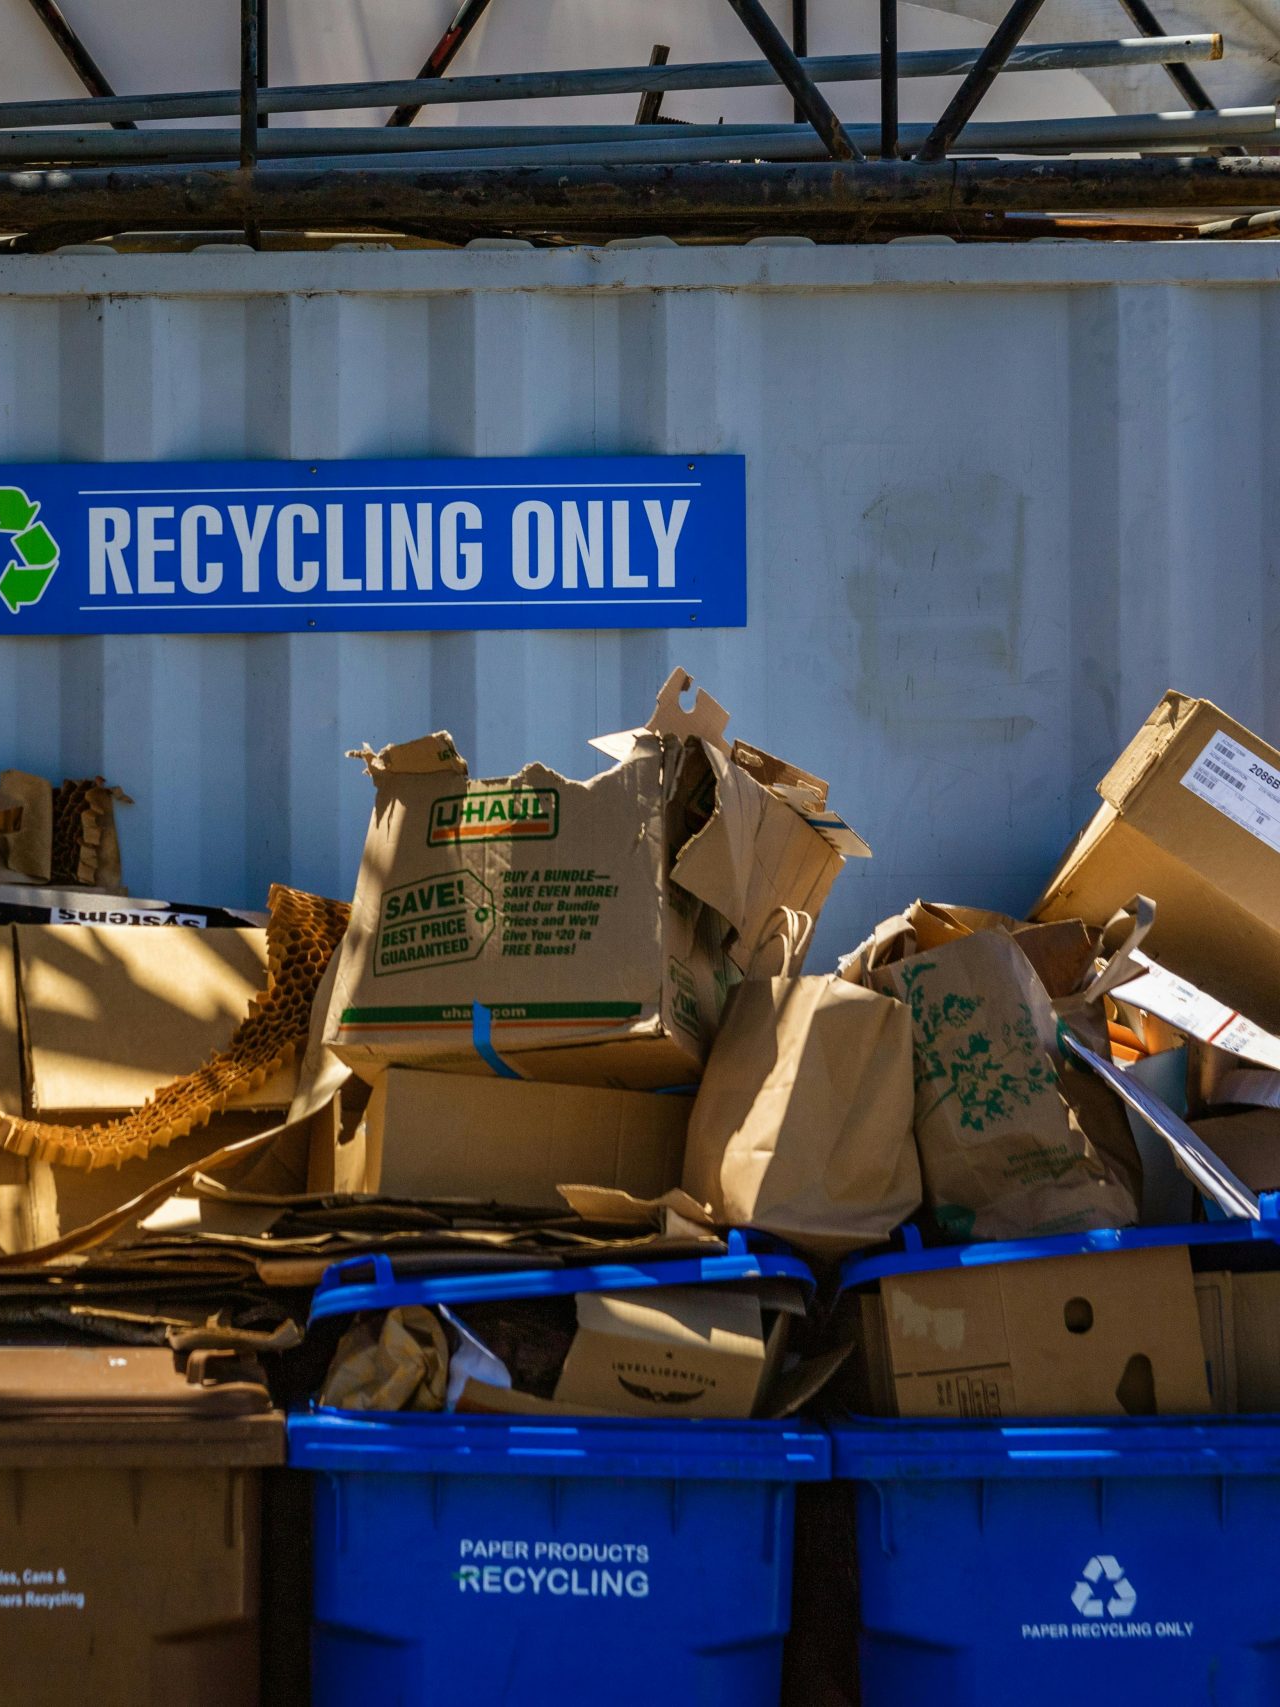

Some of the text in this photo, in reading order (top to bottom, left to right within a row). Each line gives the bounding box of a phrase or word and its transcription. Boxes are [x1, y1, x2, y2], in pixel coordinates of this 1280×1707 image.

[88, 499, 691, 595] RECYCLING ONLY
[531, 870, 540, 882] A
[385, 880, 466, 920] SAVE!
[503, 885, 619, 898] SAVE EVEN MORE!
[503, 900, 600, 913] Beat Our Bundle
[503, 914, 599, 927] Prices and We'll
[382, 918, 467, 949] BEST PRICE
[502, 929, 527, 941] Give
[531, 929, 552, 941] You
[579, 928, 592, 940] in
[502, 943, 577, 956] FREE Boxes!
[460, 1539, 650, 1564] PAPER PRODUCTS
[22, 1568, 54, 1585] Cans
[458, 1565, 650, 1598] RECYCLING
[25, 1591, 85, 1610] Recycling
[1021, 1621, 1194, 1639] PAPER RECYCLING ONLY
